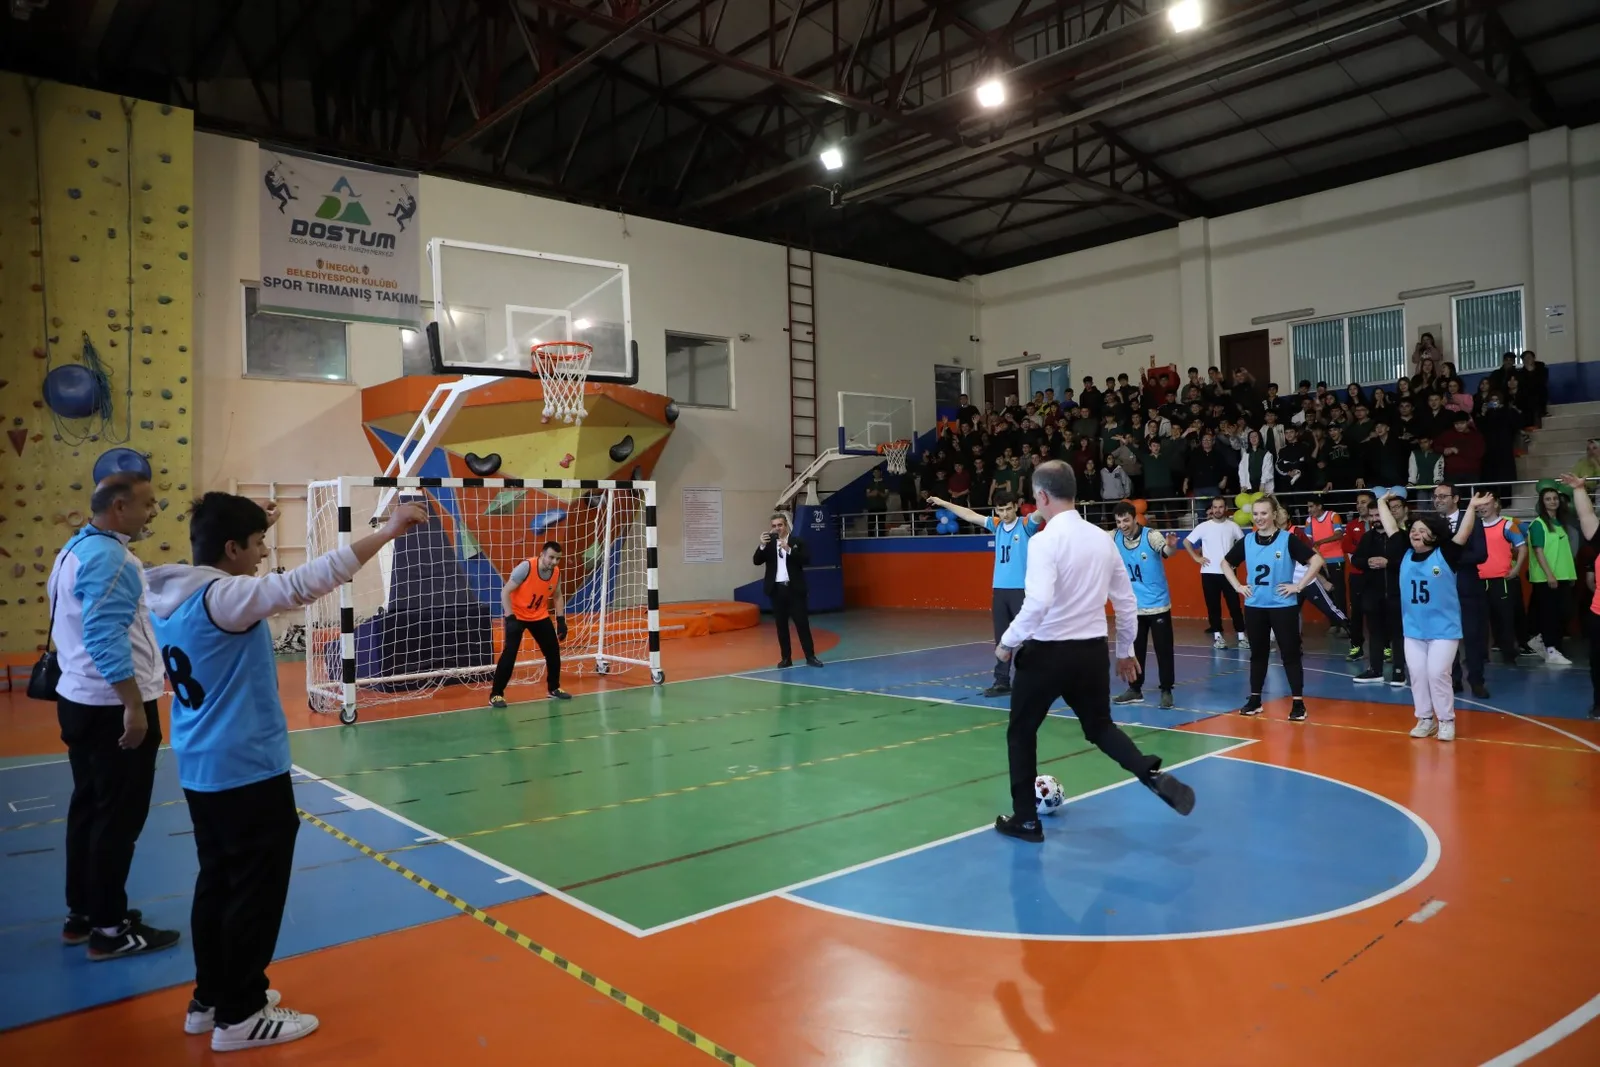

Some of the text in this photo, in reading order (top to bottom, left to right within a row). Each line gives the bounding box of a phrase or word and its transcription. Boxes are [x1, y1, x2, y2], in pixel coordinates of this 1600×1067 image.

[289, 236, 308, 245] DOĞA
[308, 239, 339, 250] SPORLARI
[290, 218, 396, 250] DOSTUM
[286, 267, 398, 290] BELEDİYESPOR KULÜBÜ
[325, 260, 362, 275] İNEGÖL
[262, 275, 418, 305] SPOR TIRMANIŞ TAKIMI
[1128, 563, 1143, 583] 14
[1254, 564, 1271, 586] 2
[527, 593, 544, 611] 14
[1410, 579, 1431, 605] 15
[162, 644, 206, 711] 8
